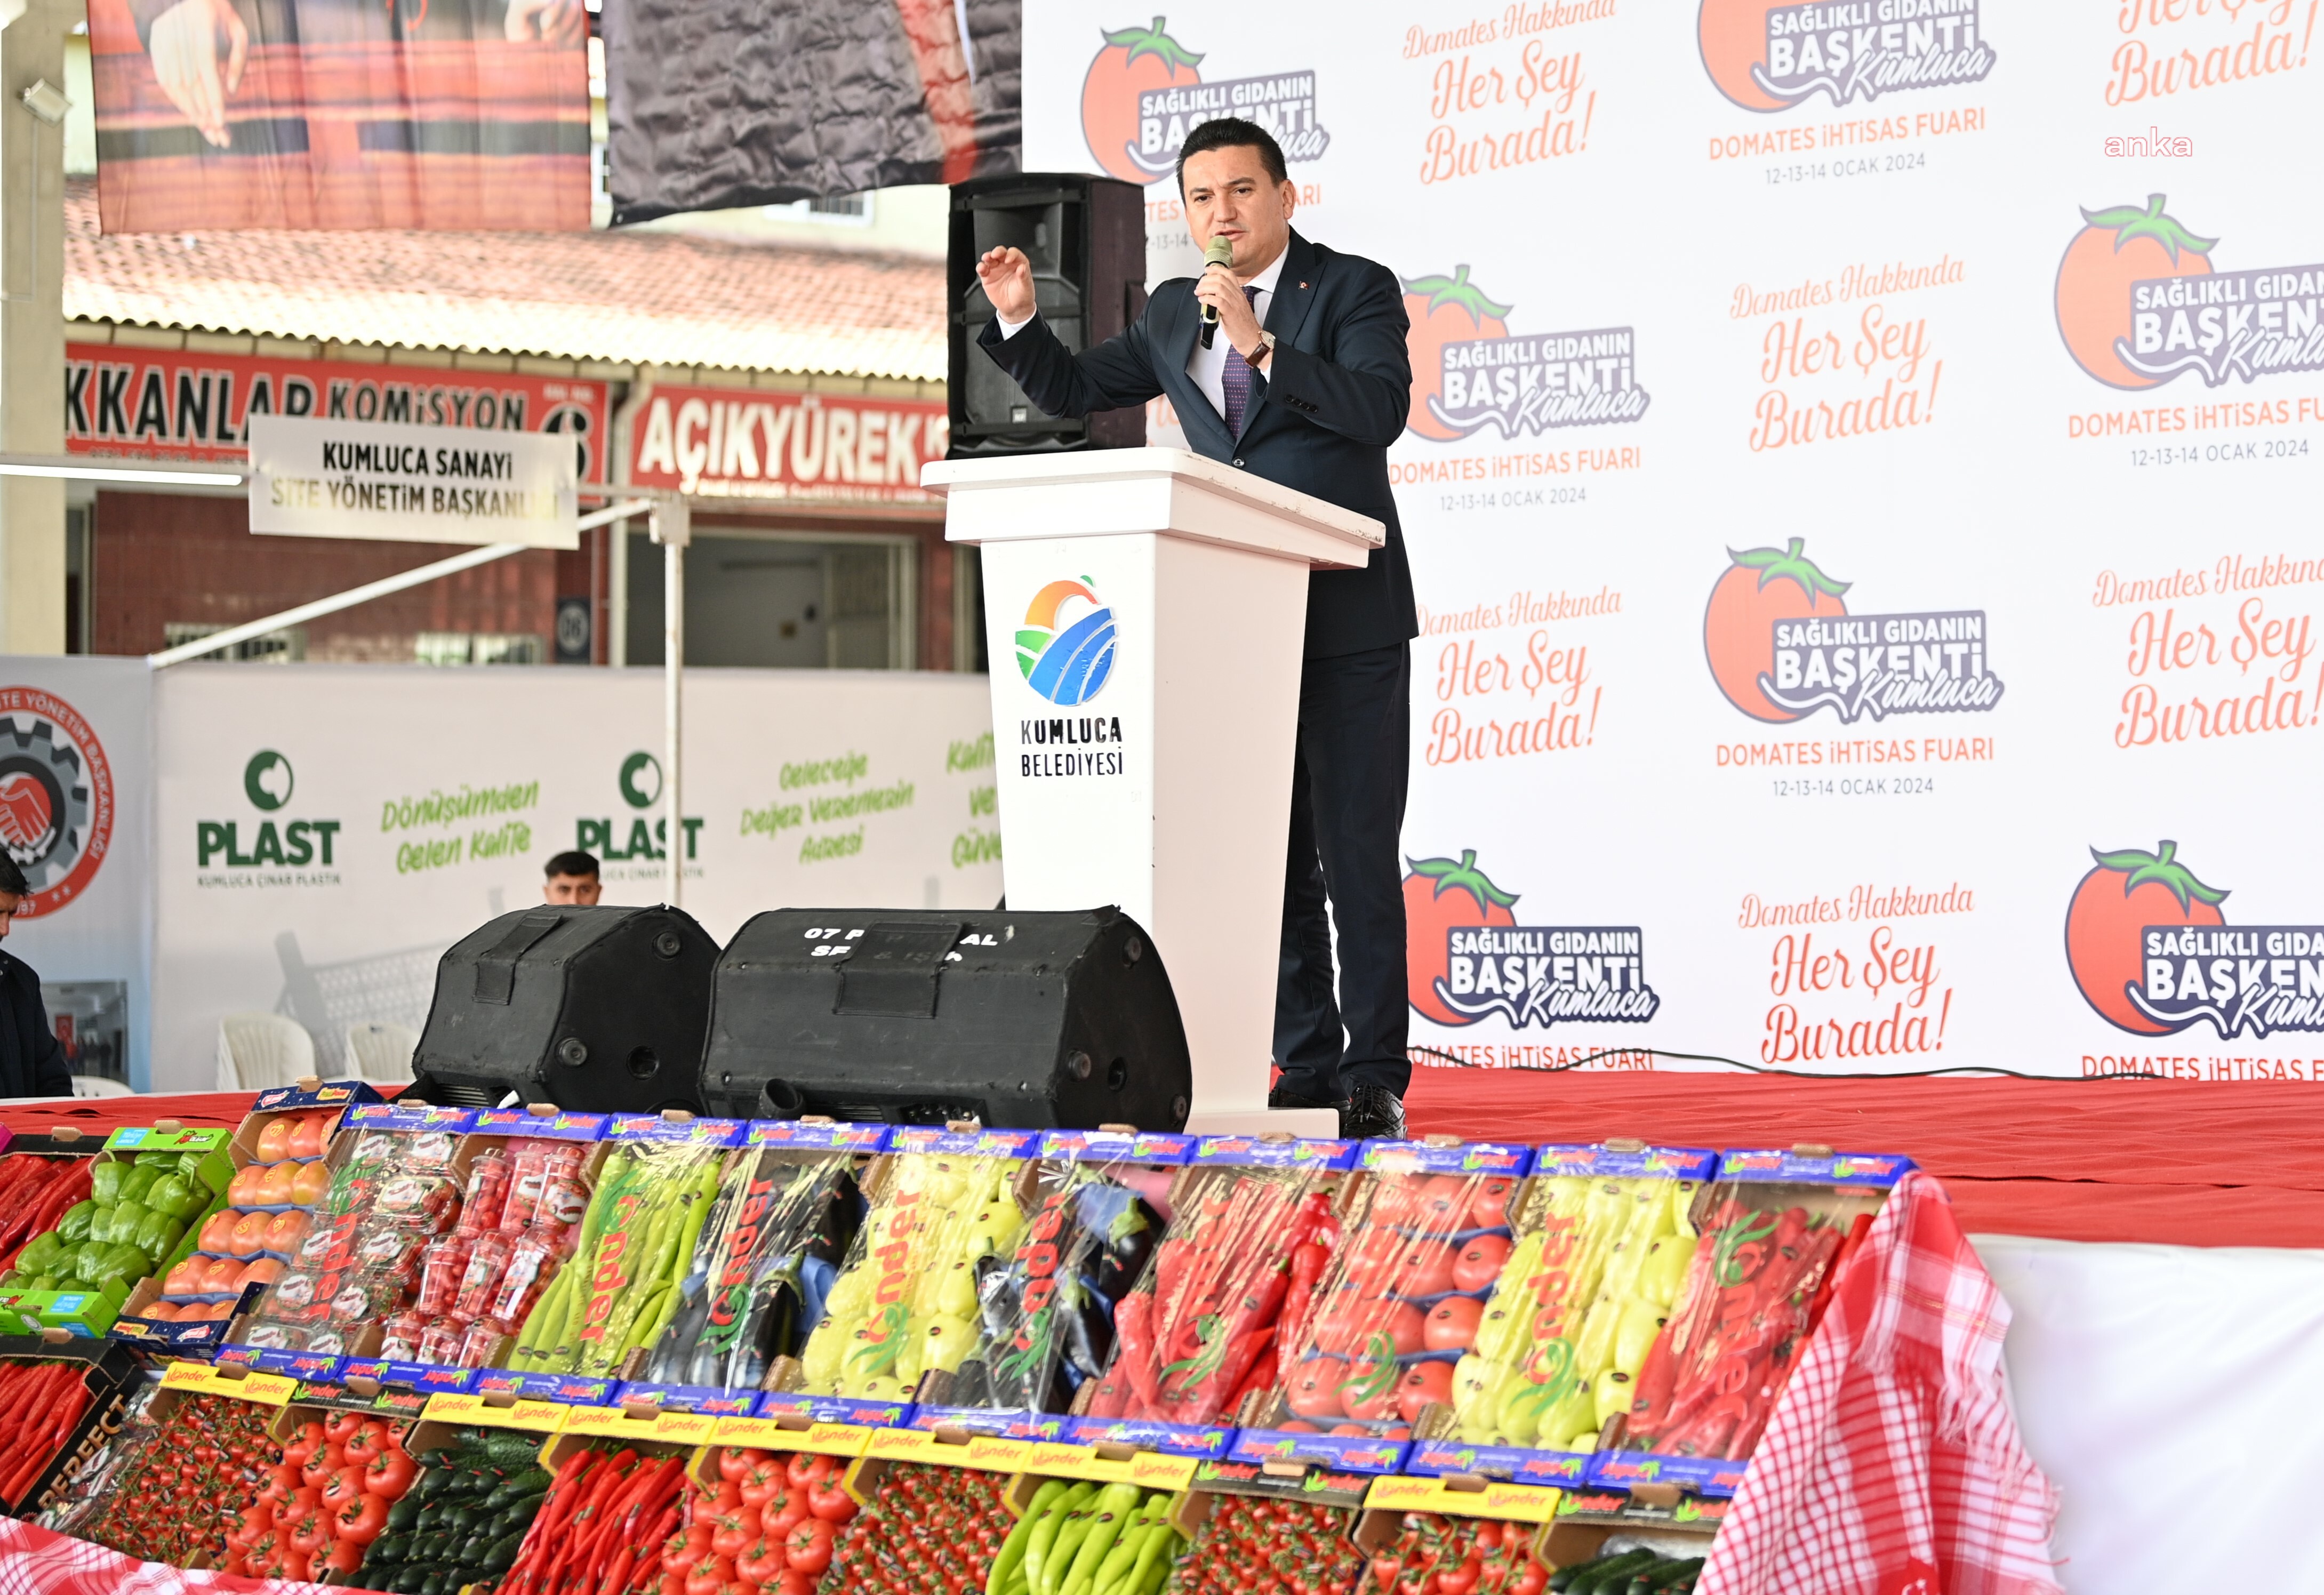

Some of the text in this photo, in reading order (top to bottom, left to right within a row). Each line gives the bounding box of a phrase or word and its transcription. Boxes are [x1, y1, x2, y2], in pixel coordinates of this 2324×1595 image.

[1403, 19, 1497, 59] Domates
[1770, 4, 1871, 36] SAĞLIKLI
[1845, 43, 1992, 99] Kumluca
[2105, 0, 2318, 106] Burada!
[1142, 76, 1312, 117] SAĞLIKLI GIDANIN
[1432, 39, 1585, 119] Her Şey
[1420, 90, 1596, 185] Burada!
[1710, 127, 1815, 160] DOMATES
[1916, 107, 1985, 137] FUARI
[1766, 153, 1926, 184] 12-13-14 OCAK 2024
[1730, 279, 1834, 319] Domates
[2136, 278, 2246, 310] SAĞLIKLI
[1761, 303, 1930, 383] Her Şey
[2135, 299, 2324, 356] BAŞKEN
[1445, 332, 1631, 370] SAĞLIKLI GIDANIN
[1512, 383, 1646, 431] Kumluca
[1750, 359, 1943, 452] Burada!
[2069, 407, 2186, 438] DOMATES
[323, 442, 428, 475] KUMLUCA
[638, 394, 923, 494] AÇIKYÜREK
[2131, 439, 2309, 466] 12-13-14 OCAK 2024
[1390, 458, 1485, 484] DOMATES
[1577, 446, 1640, 472] FUARI
[1441, 488, 1586, 510] 12-13-14 OCAK 2024
[2093, 568, 2209, 607] Domates
[1776, 616, 1982, 647] SAĞLIKLI GIDANIN
[2128, 597, 2317, 683] Her Şey
[1437, 629, 1592, 707] Her Şey
[1852, 668, 2000, 717] Kumluca
[2115, 660, 2324, 749] Burada!
[1020, 717, 1122, 744] KUMLUCA
[1426, 686, 1602, 766] Burada!
[1021, 747, 1123, 777] BELEDİYESİ
[1716, 742, 1823, 767] DOMATES
[1924, 737, 1994, 762] FUARI
[381, 781, 539, 832] Dönüşümden
[1773, 778, 1934, 796] 12-13-14 OCAK 2024
[197, 820, 340, 867] PLAST
[397, 836, 462, 873] Gelen
[1738, 893, 1842, 929] Domates
[804, 928, 842, 939] 07
[1451, 927, 1638, 955] SAĞLIKLI GIDANIN
[2146, 926, 2259, 956] SAĞLIKLI
[1770, 926, 1941, 1008] Her Şey
[2146, 959, 2324, 1009] BAŞKEN
[1520, 978, 1656, 1023] Kumluca
[1761, 988, 1952, 1063] Burada!
[1589, 1046, 1654, 1070] FUARI
[2082, 1056, 2200, 1081] DOMATES
